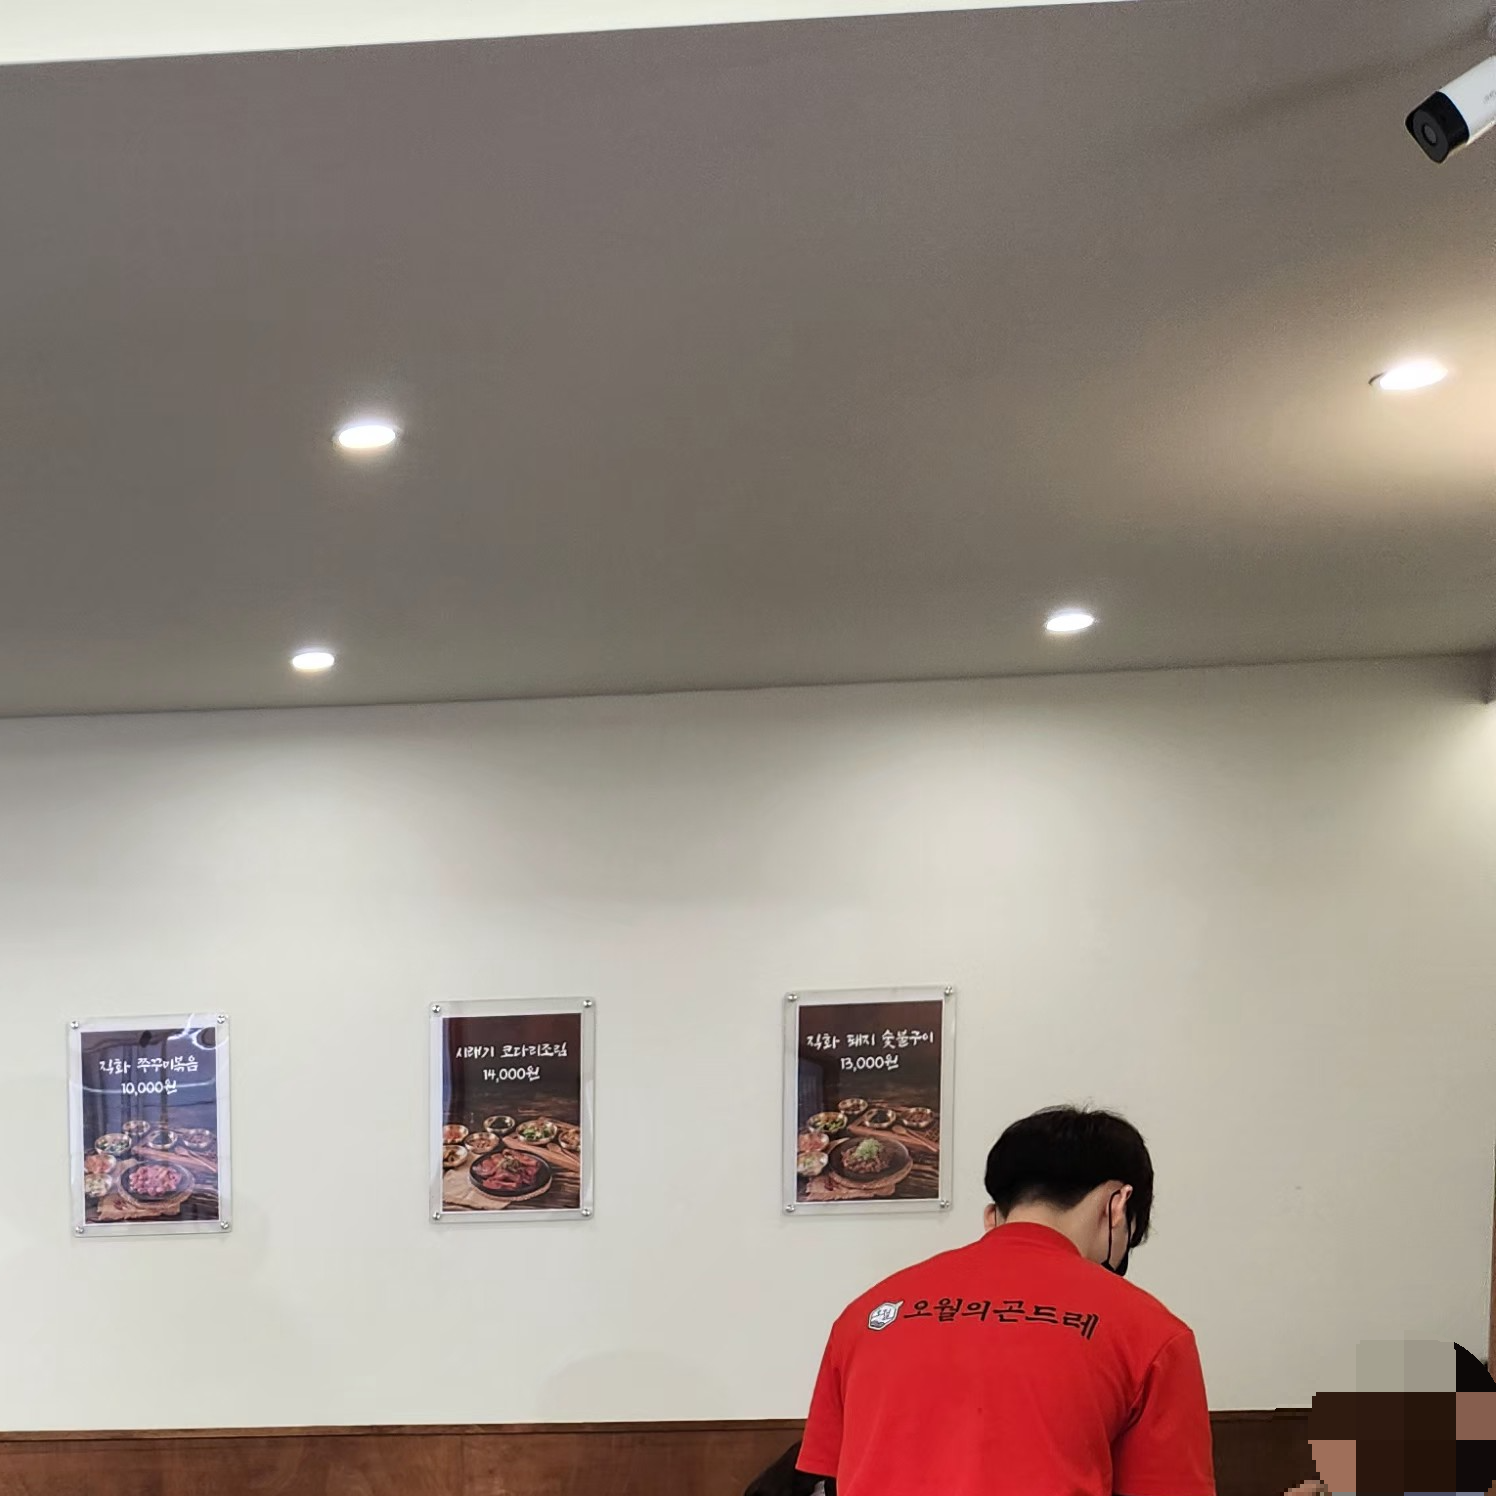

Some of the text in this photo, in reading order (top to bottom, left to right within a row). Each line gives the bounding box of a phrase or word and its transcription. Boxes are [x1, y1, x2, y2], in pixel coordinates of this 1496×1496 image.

[806, 1028, 934, 1050] 직화 돼지 숯불구이
[455, 1041, 568, 1059] 시래기 코다리조림
[99, 1055, 199, 1075] 직화 쭈꾸미볶음
[840, 1053, 899, 1073] 13,000원
[483, 1065, 541, 1083] 14,000원
[121, 1078, 178, 1097] 10,000원
